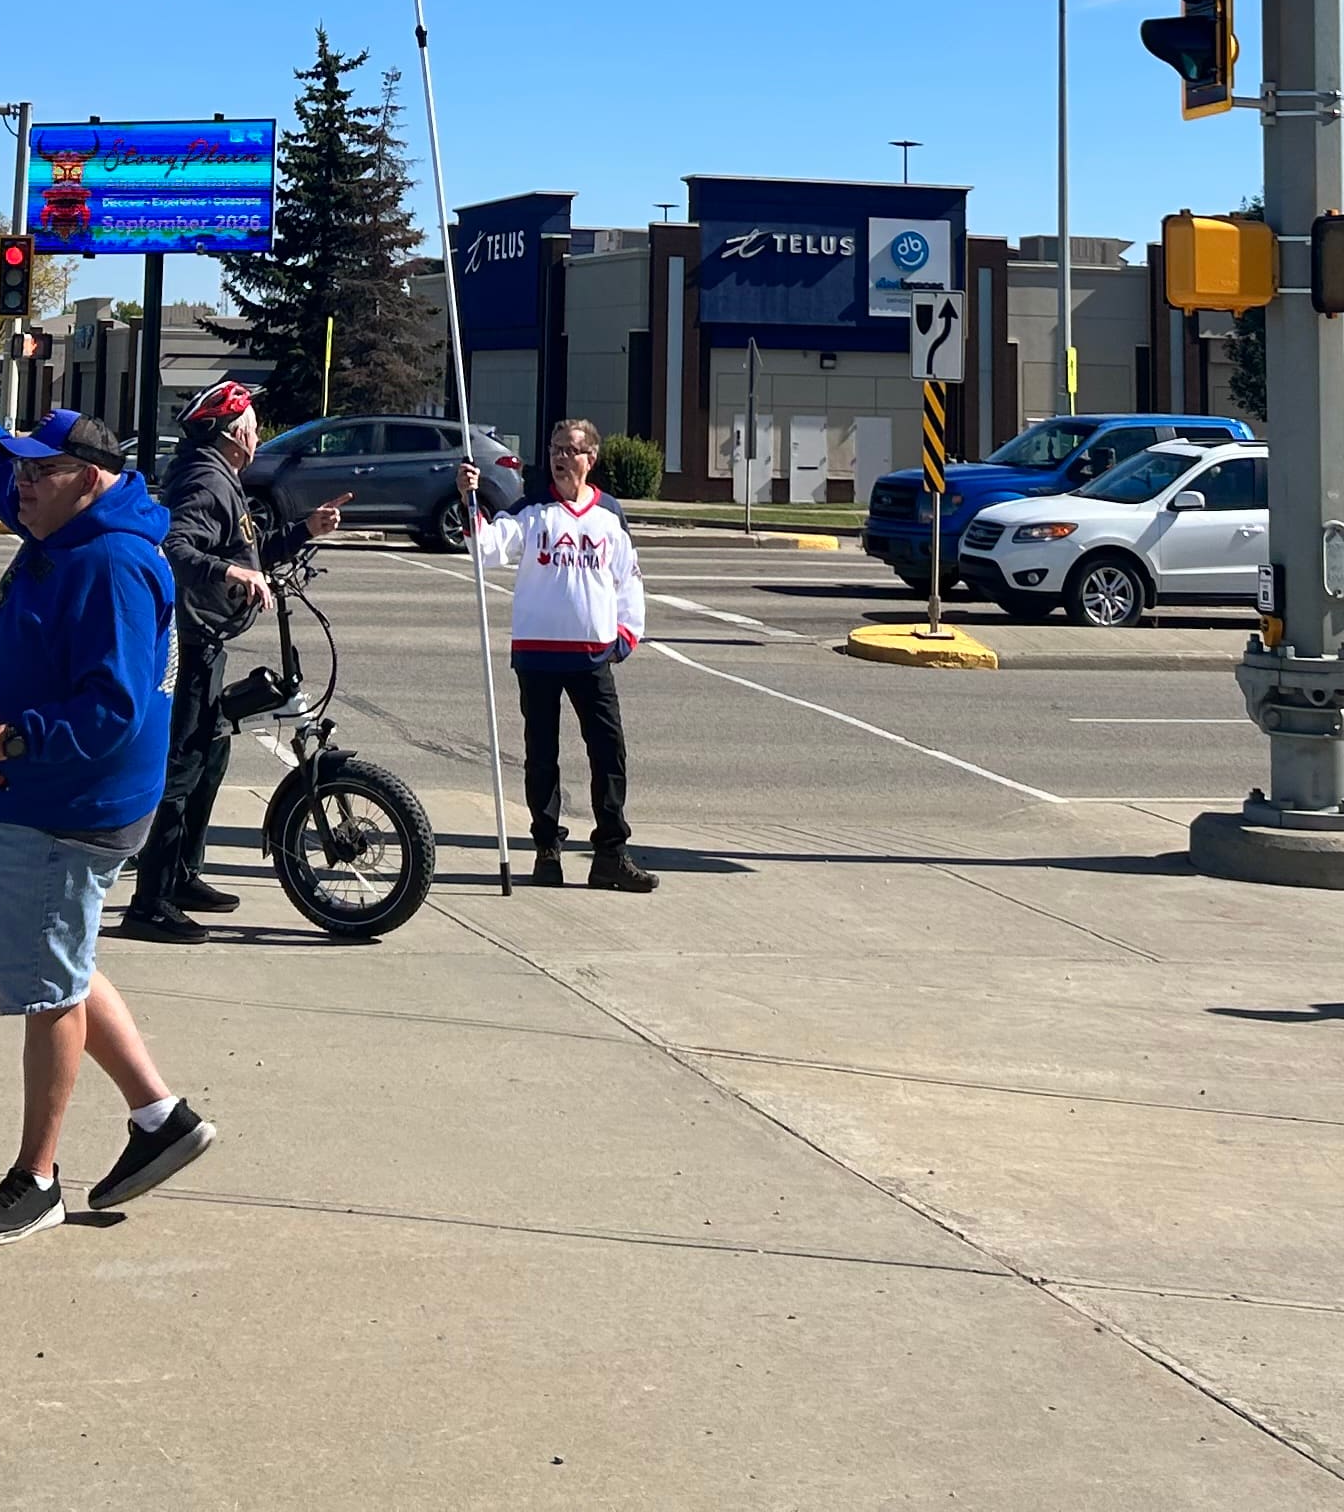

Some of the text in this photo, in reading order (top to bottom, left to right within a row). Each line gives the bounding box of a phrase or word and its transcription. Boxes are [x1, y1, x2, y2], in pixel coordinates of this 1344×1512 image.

[103, 138, 260, 178] Stony Plain
[101, 215, 209, 235] September
[486, 230, 525, 262] TELUS
[772, 233, 856, 256] TELUS
[552, 531, 607, 553] AM
